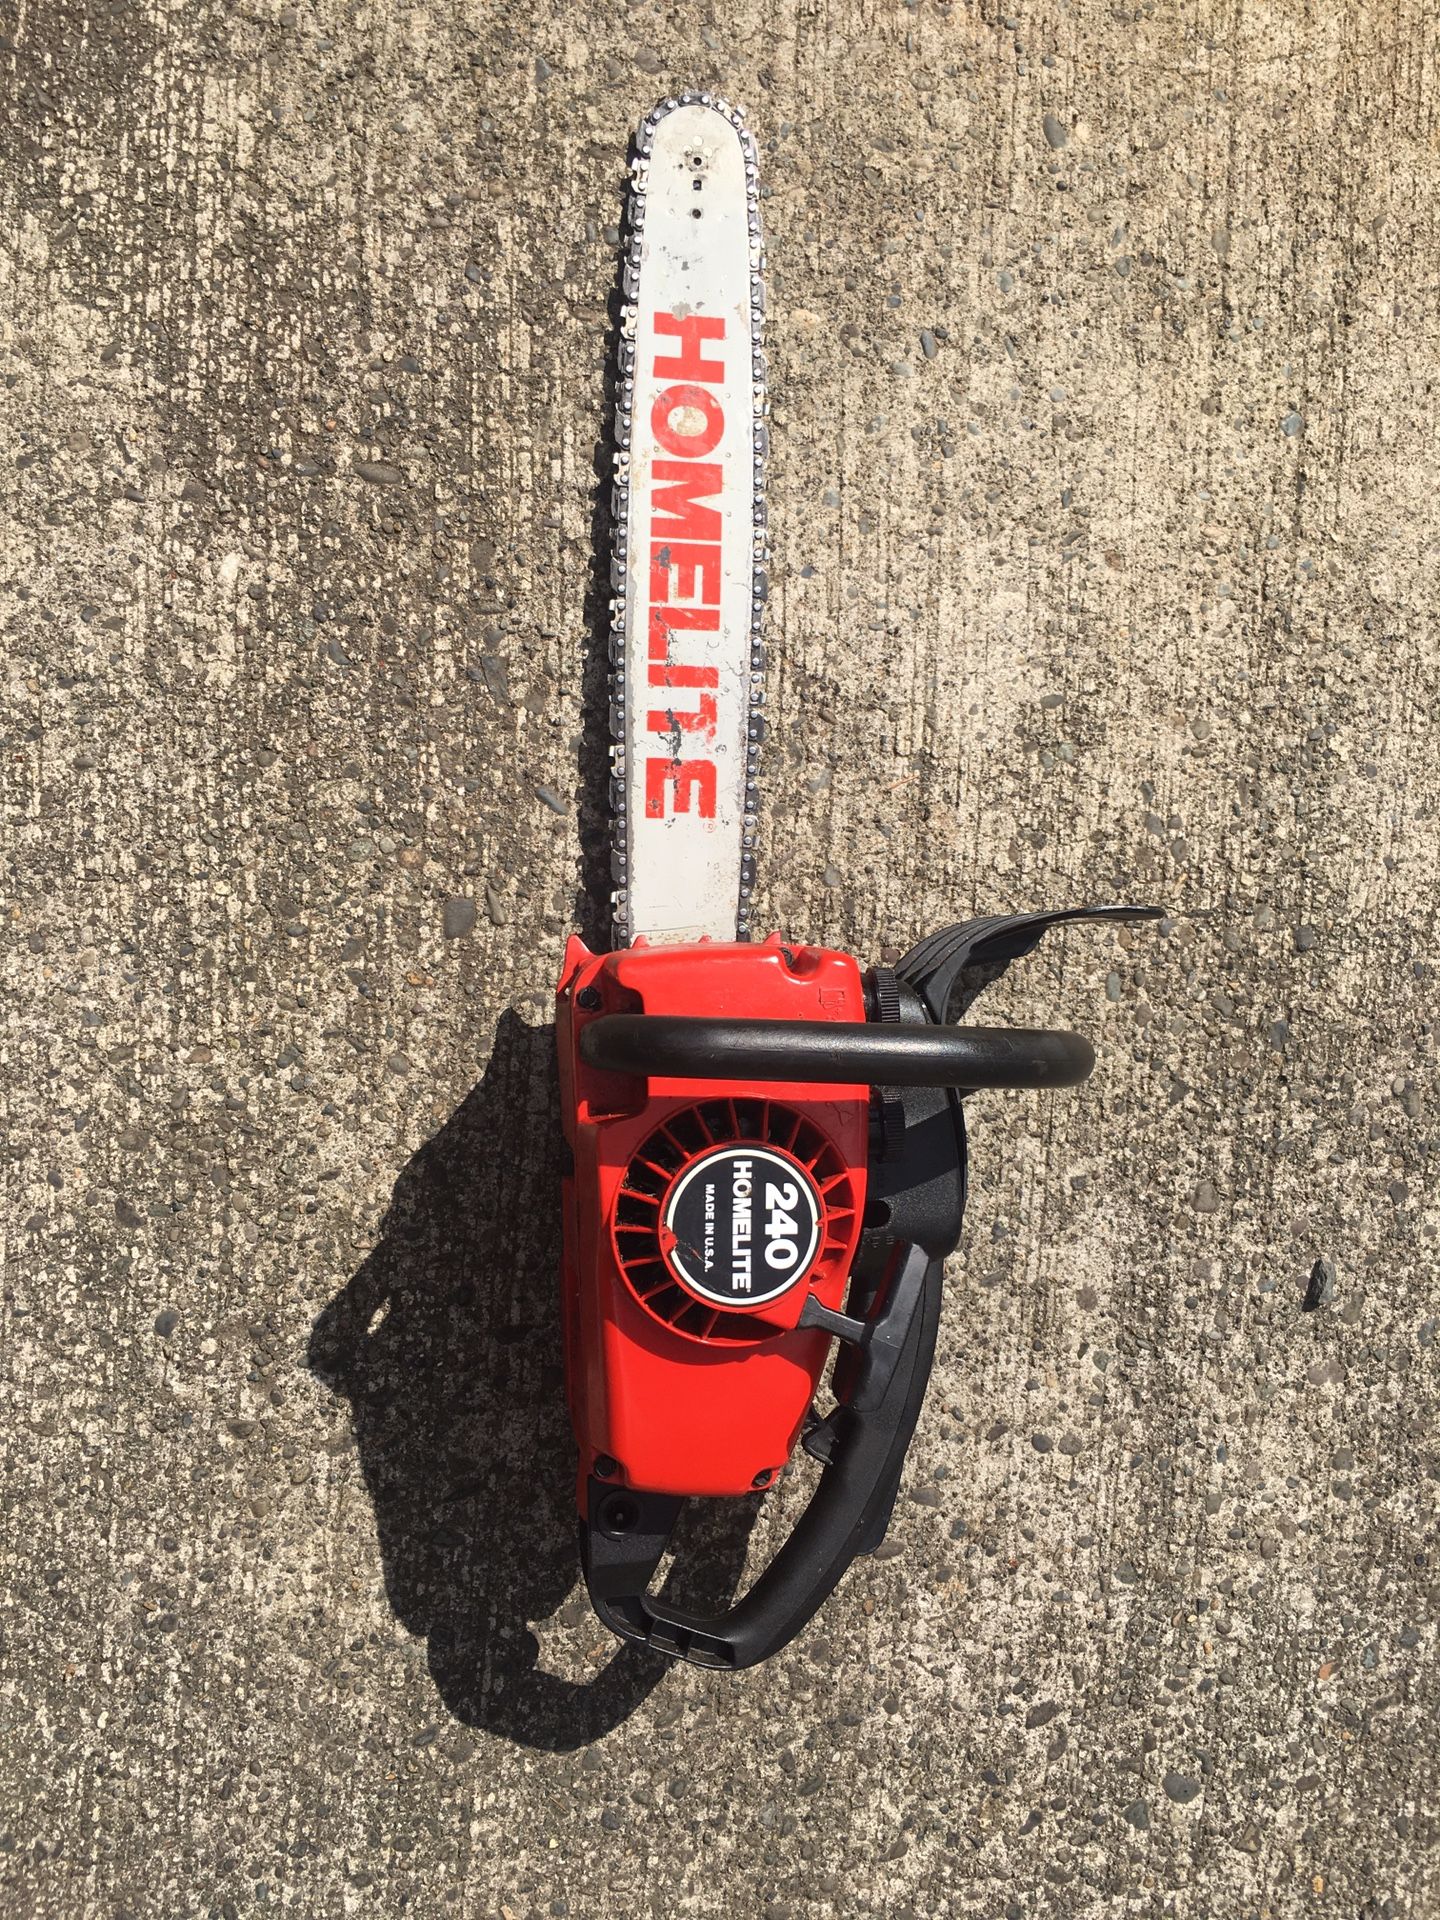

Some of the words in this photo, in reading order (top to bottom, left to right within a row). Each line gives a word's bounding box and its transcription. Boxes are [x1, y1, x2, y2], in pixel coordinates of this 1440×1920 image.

[645, 312, 726, 820] HOMELITE
[704, 1184, 715, 1220] MADE
[704, 1222, 715, 1235] IN
[732, 1160, 753, 1291] HOMELITE
[764, 1182, 799, 1270] 240
[704, 1237, 715, 1272] U.S.A.
